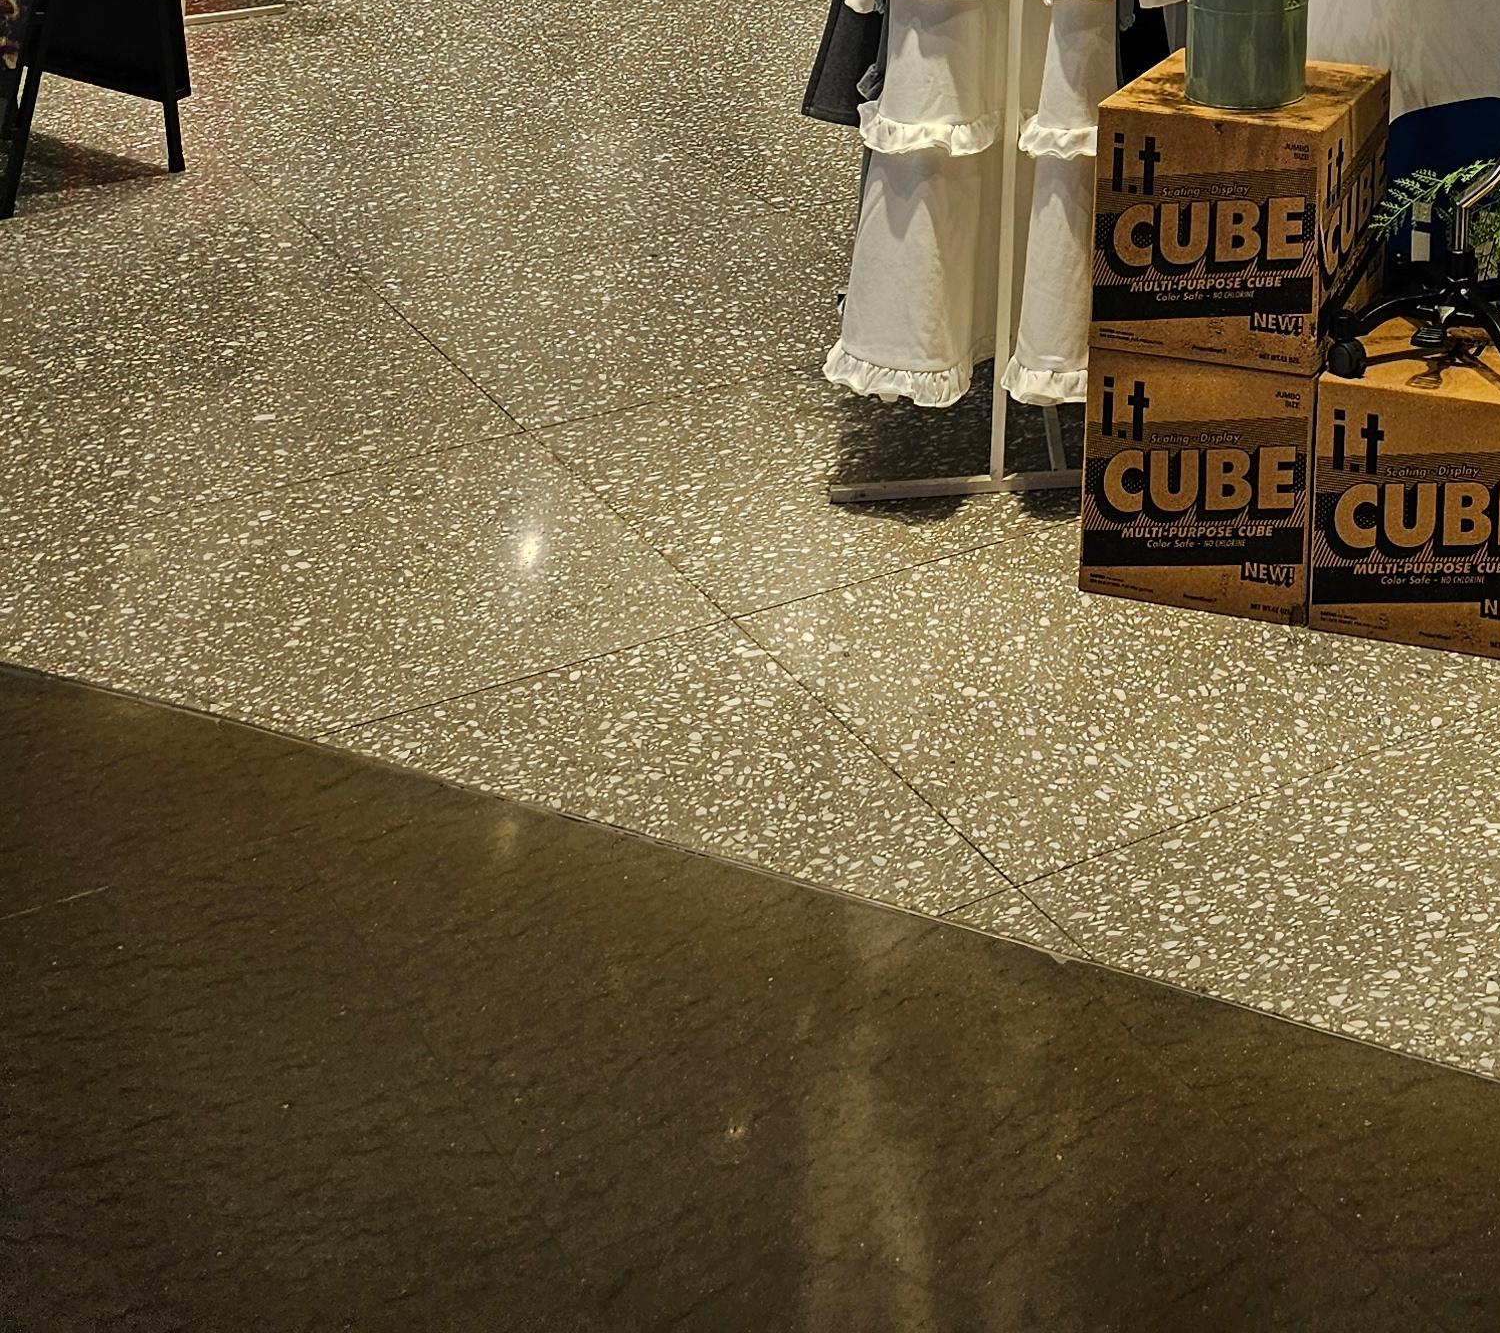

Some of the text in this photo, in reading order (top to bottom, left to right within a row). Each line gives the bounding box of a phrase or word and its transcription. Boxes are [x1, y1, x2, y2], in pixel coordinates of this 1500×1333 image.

[1112, 132, 1161, 195] i.t
[1162, 185, 1251, 199] Seating Display
[1112, 196, 1306, 268] CUBE
[1130, 276, 1283, 293] MULTI-PURPOSE CUBE
[1156, 292, 1180, 302] Color
[1183, 291, 1204, 301] Safe
[1253, 312, 1304, 333] NEW!
[1275, 391, 1301, 401] JUMBO
[1101, 376, 1150, 441] i.t
[1151, 432, 1241, 446] Seating Display
[1333, 408, 1385, 474] i.t
[1385, 465, 1480, 478] Seating Display
[1103, 446, 1297, 513] CUBE
[1121, 525, 1273, 539] MULTI-PURPOSE CUBE
[1146, 539, 1172, 548] Color
[1174, 539, 1195, 548] Safe
[1244, 562, 1296, 583] NEW!
[1353, 563, 1473, 576] MULTI-PURPOSE
[1381, 575, 1408, 585] Color
[1410, 575, 1431, 584] Safe
